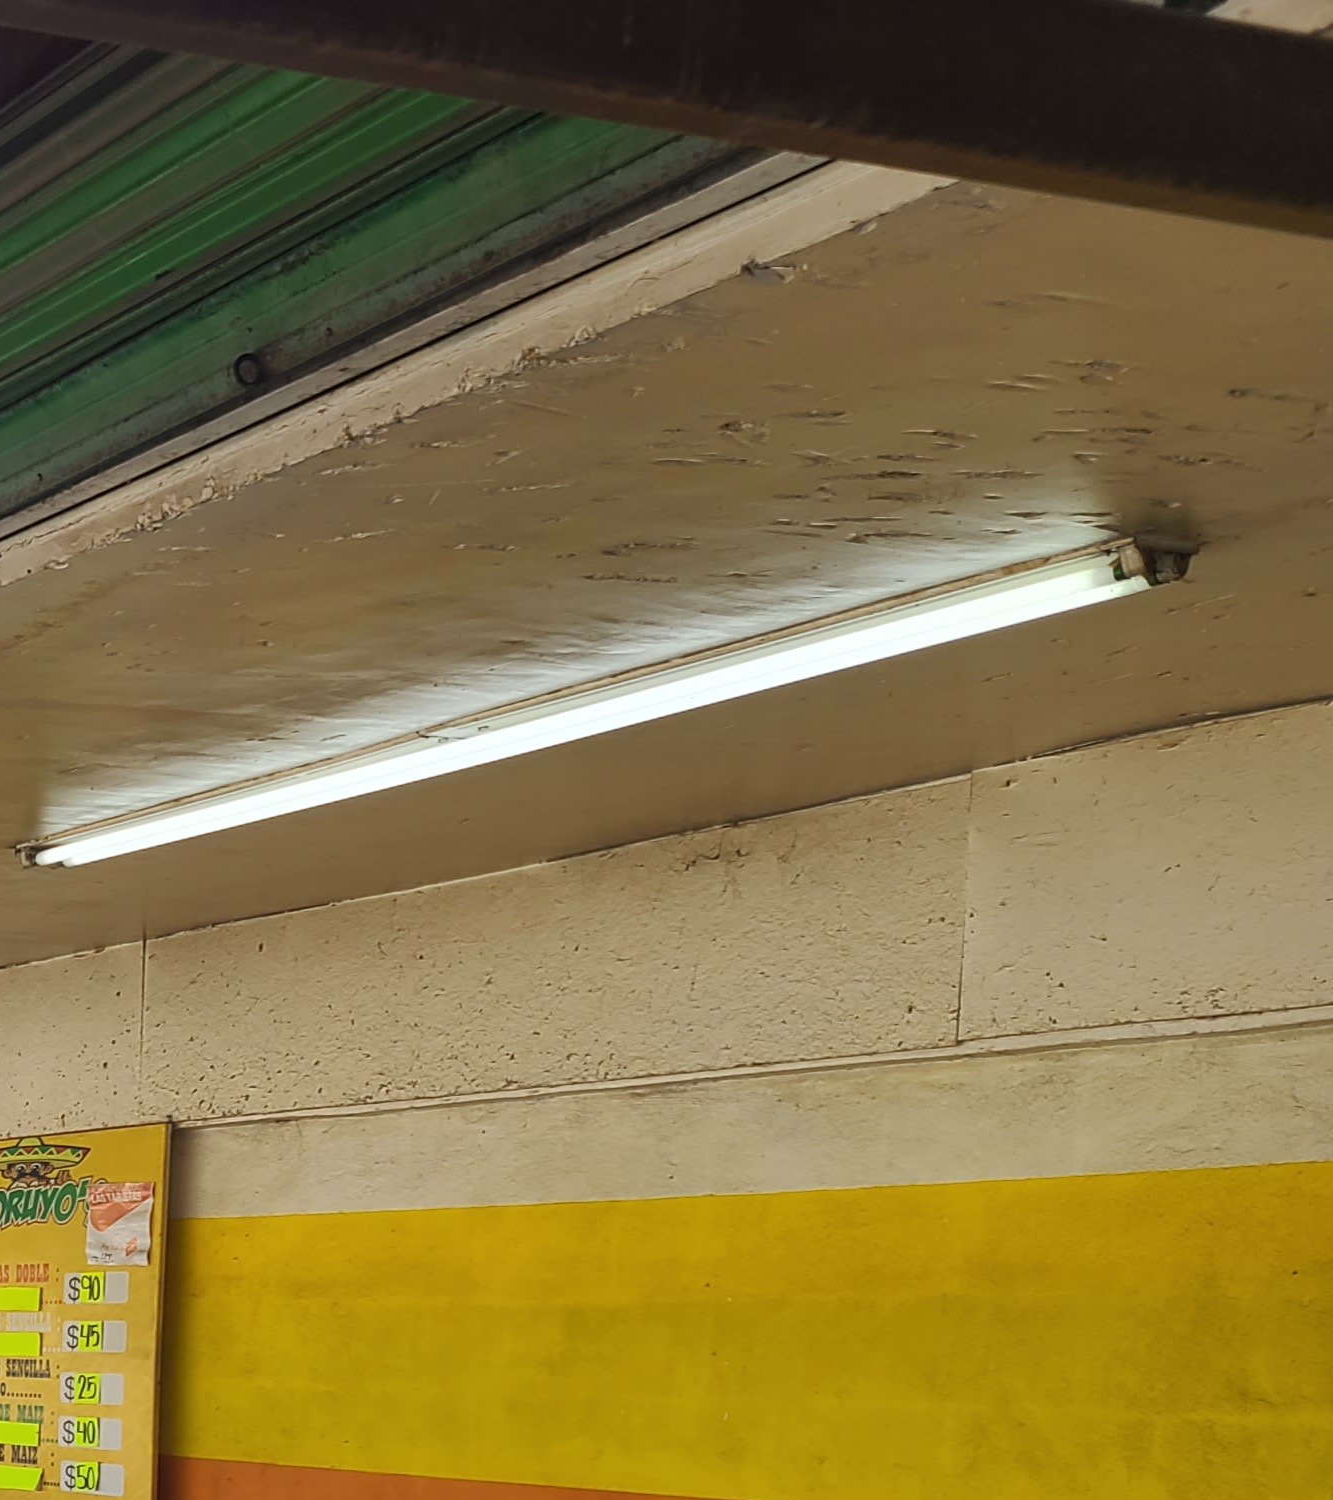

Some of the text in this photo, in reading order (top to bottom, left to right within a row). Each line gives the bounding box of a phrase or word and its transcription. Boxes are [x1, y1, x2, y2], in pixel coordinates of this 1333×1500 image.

[16, 1263, 50, 1283] DOBLE
[68, 1275, 100, 1303] $90
[5, 1312, 51, 1333] SENCILLA
[66, 1324, 100, 1349] $45
[6, 1359, 51, 1378] SENCILLA
[64, 1374, 97, 1402] $25
[17, 1404, 44, 1424] MAIZ
[62, 1420, 95, 1446] $40
[11, 1445, 38, 1464] MAIZ
[65, 1464, 95, 1491] $50
